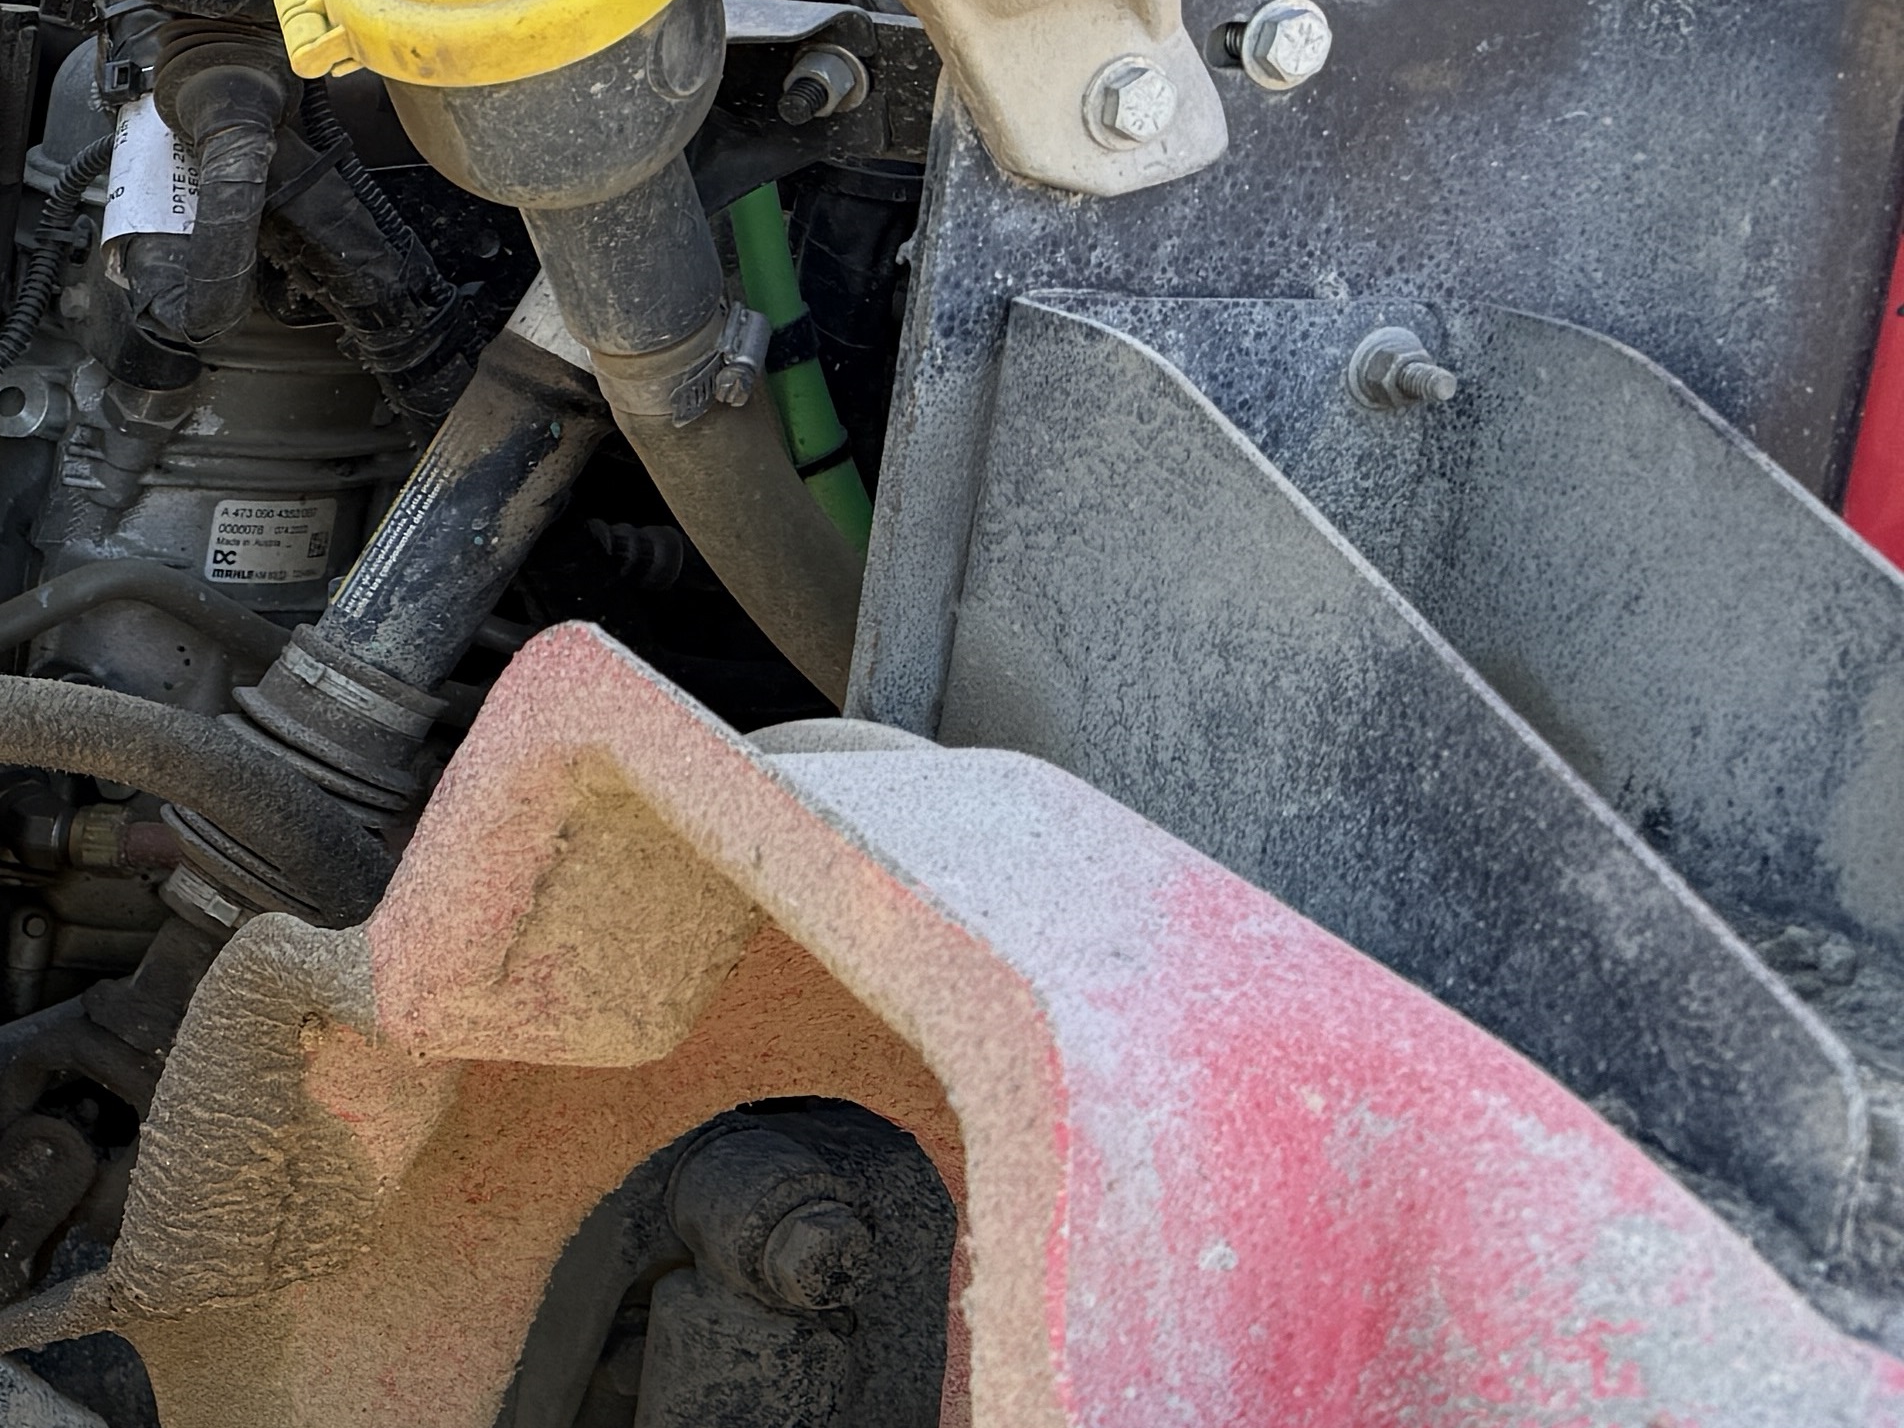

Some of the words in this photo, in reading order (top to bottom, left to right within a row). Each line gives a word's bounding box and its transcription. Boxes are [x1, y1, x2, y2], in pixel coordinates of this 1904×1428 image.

[221, 507, 229, 517] A
[212, 549, 237, 566] DC
[211, 568, 254, 580] MAHLE
